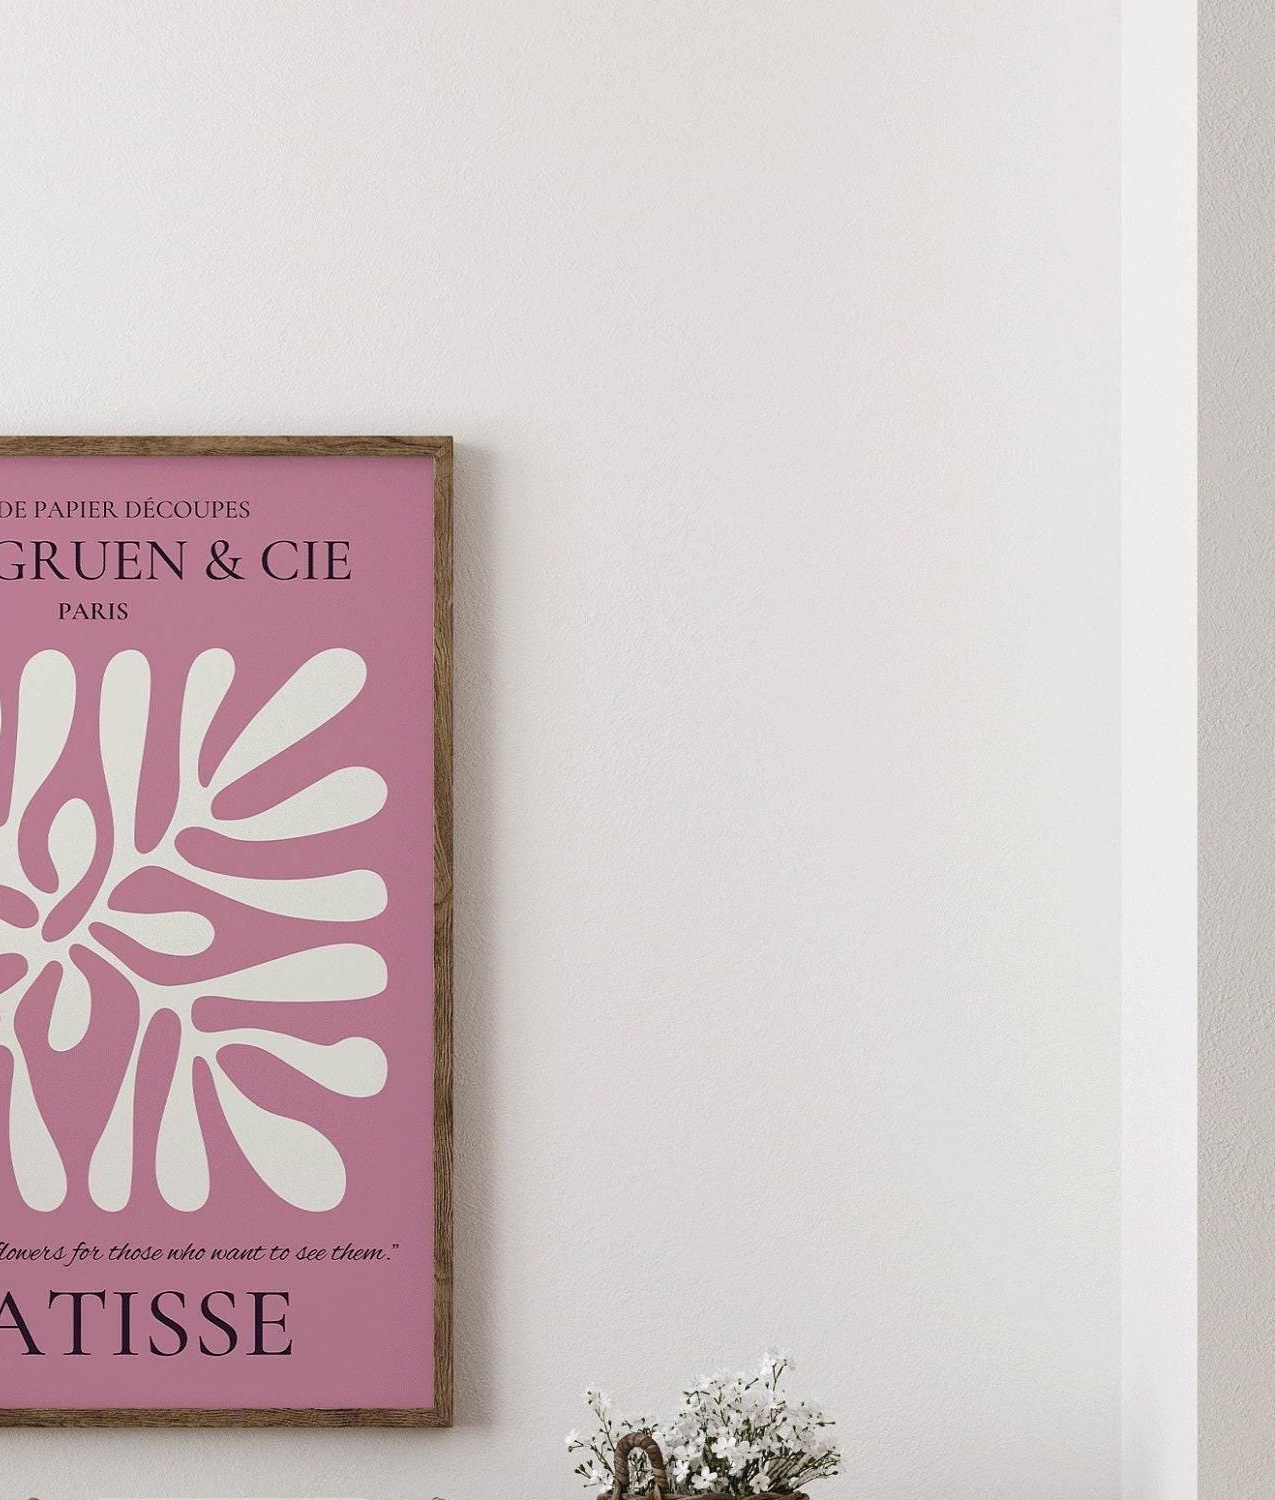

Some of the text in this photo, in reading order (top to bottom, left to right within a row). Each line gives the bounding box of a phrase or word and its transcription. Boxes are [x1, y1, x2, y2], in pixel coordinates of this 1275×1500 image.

[34, 500, 119, 519] PAPIER
[124, 497, 251, 519] DÉCOUPES
[205, 539, 246, 581] &
[261, 540, 352, 581] CIE
[57, 602, 129, 621] PARIS
[63, 1241, 104, 1267] for
[108, 1242, 163, 1261] those
[166, 1242, 207, 1261] who
[210, 1245, 267, 1261] want
[269, 1245, 290, 1261] to
[295, 1245, 328, 1261] see
